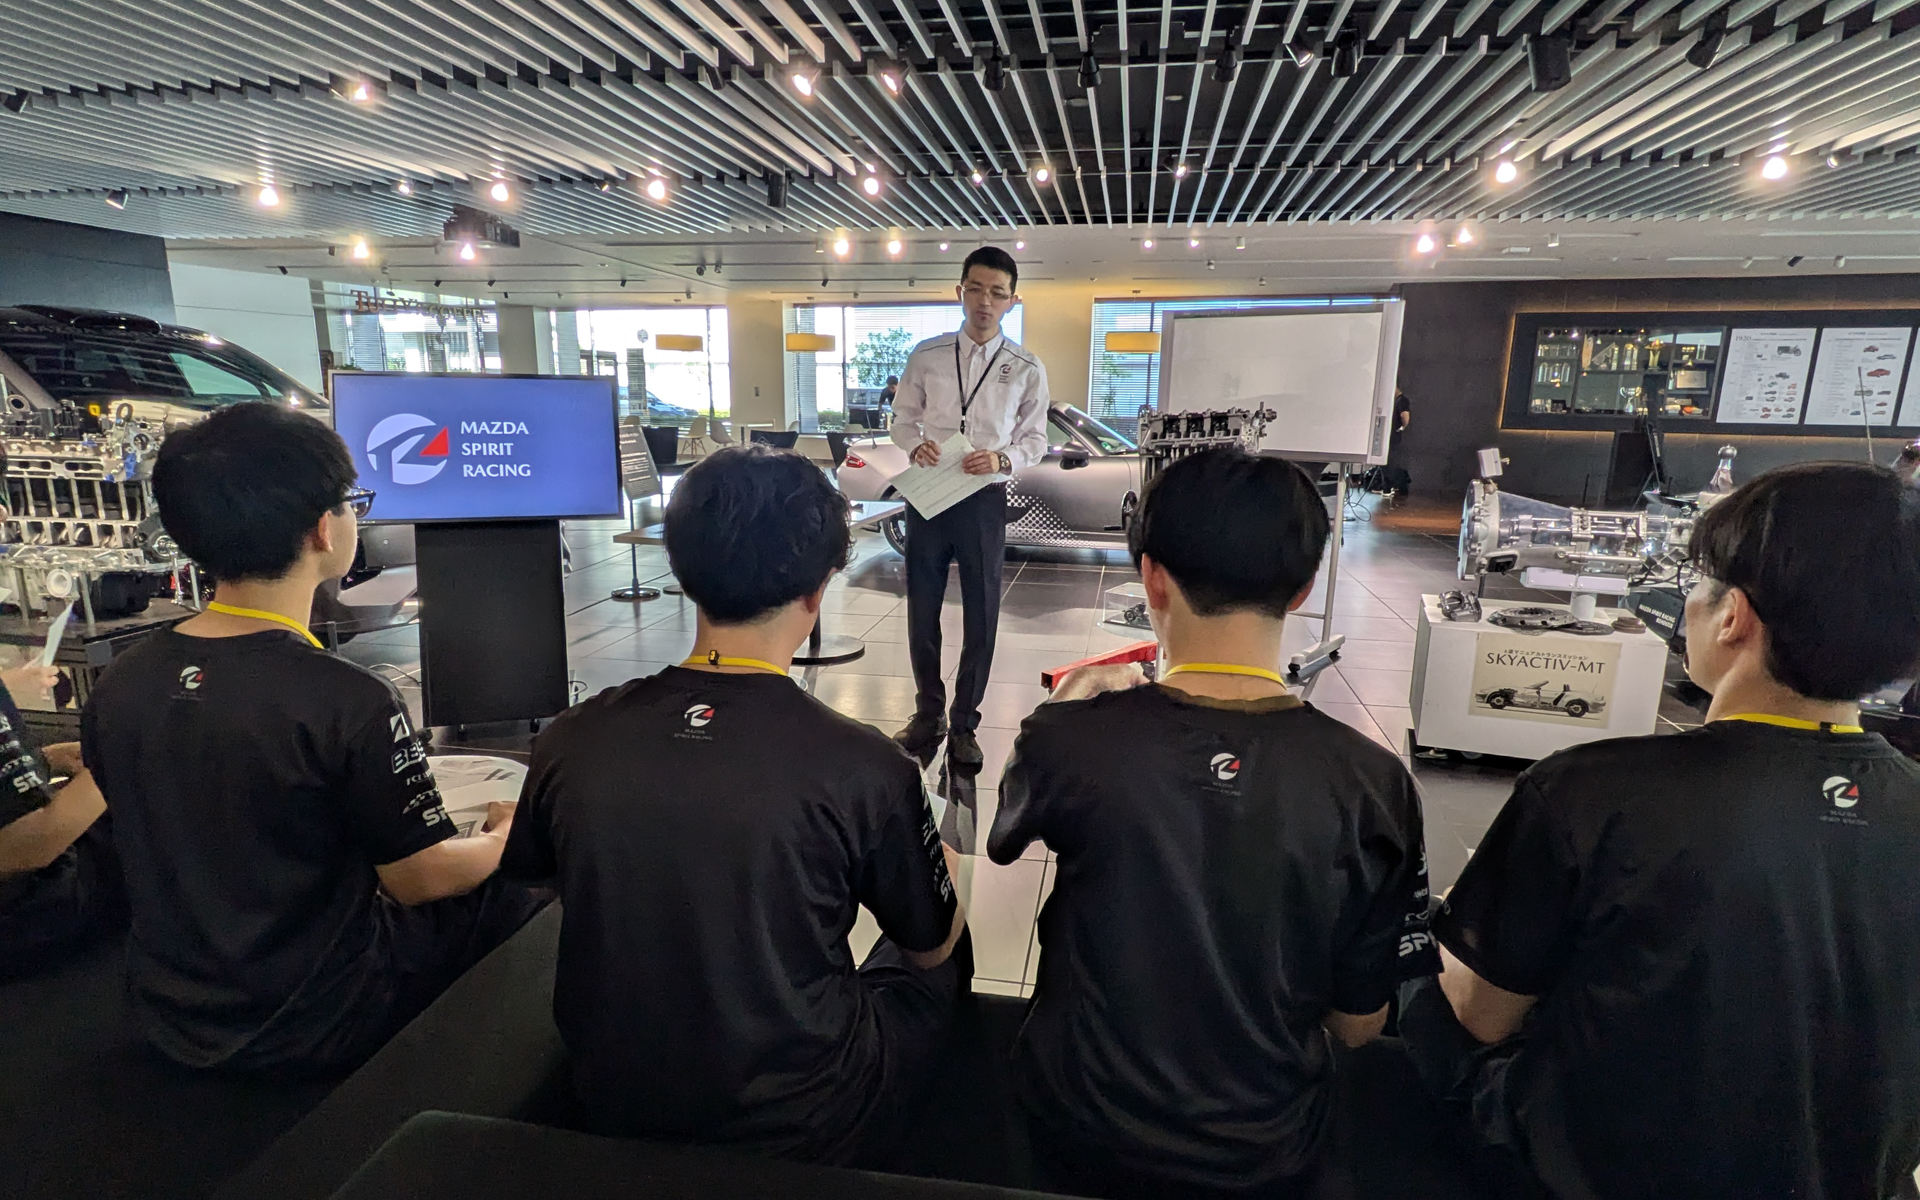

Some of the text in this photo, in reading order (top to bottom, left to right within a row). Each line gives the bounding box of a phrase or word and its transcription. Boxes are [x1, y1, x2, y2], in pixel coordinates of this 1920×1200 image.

[460, 421, 529, 435] MAZDA
[461, 442, 514, 456] SPIRIT
[463, 463, 531, 478] RACING
[1485, 652, 1606, 675] SKYACTIV-MT
